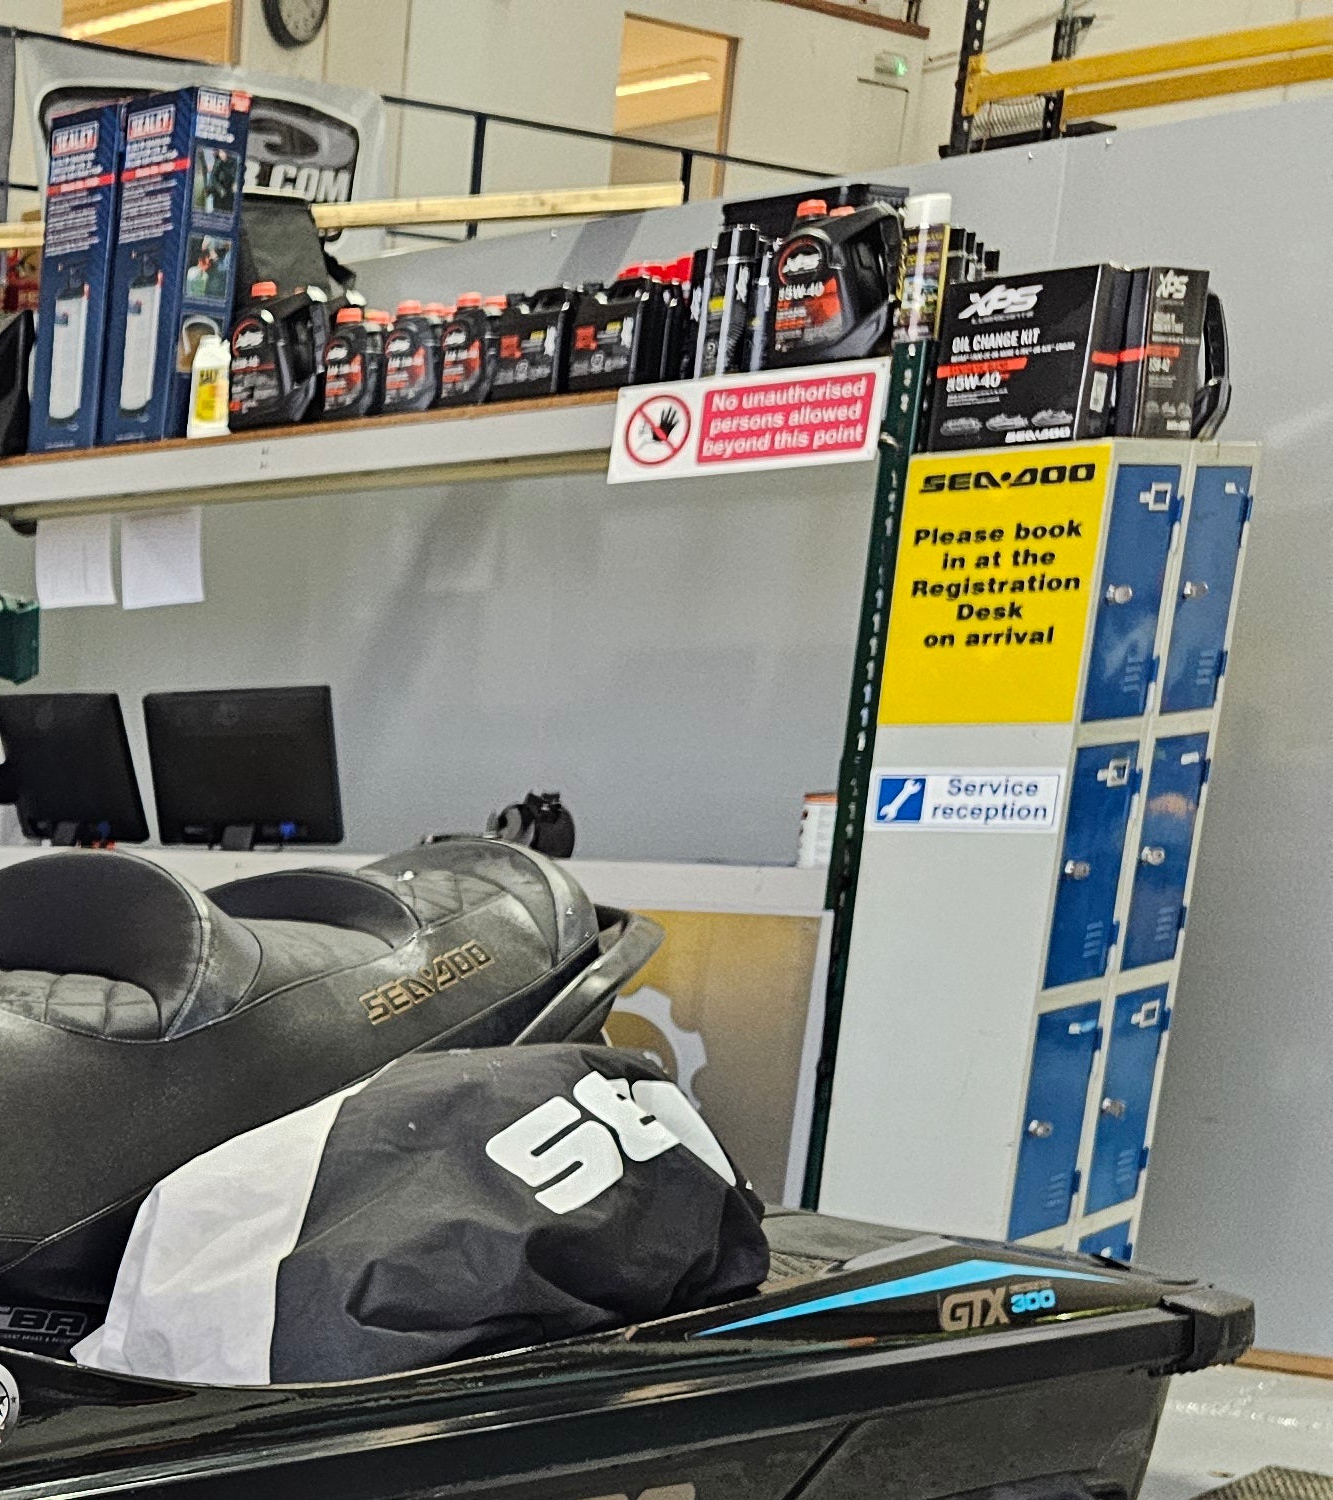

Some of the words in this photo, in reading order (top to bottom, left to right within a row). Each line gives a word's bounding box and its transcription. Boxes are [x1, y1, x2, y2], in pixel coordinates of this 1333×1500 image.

[958, 284, 1044, 320] XPS
[952, 336, 971, 354] OIL
[973, 330, 1020, 350] CHANGE
[1020, 327, 1041, 346] KIT
[711, 392, 739, 412] No
[742, 377, 868, 409] unauthorised
[709, 412, 784, 437] persons
[787, 402, 863, 427] allowed
[702, 436, 773, 460] beyond
[774, 429, 809, 449] this
[813, 423, 864, 450] point
[914, 526, 1005, 547] Please
[1014, 518, 1083, 541] book
[942, 551, 966, 570] in
[974, 549, 1001, 569] at
[1012, 546, 1056, 567] the
[911, 574, 1081, 601] Registration
[957, 602, 1023, 622] Desk
[924, 633, 955, 649] on
[965, 625, 1055, 647] arrival
[947, 777, 1039, 797] Service
[931, 802, 1048, 825] reception
[940, 1286, 1010, 1332] GTX
[1010, 1288, 1056, 1314] 300
